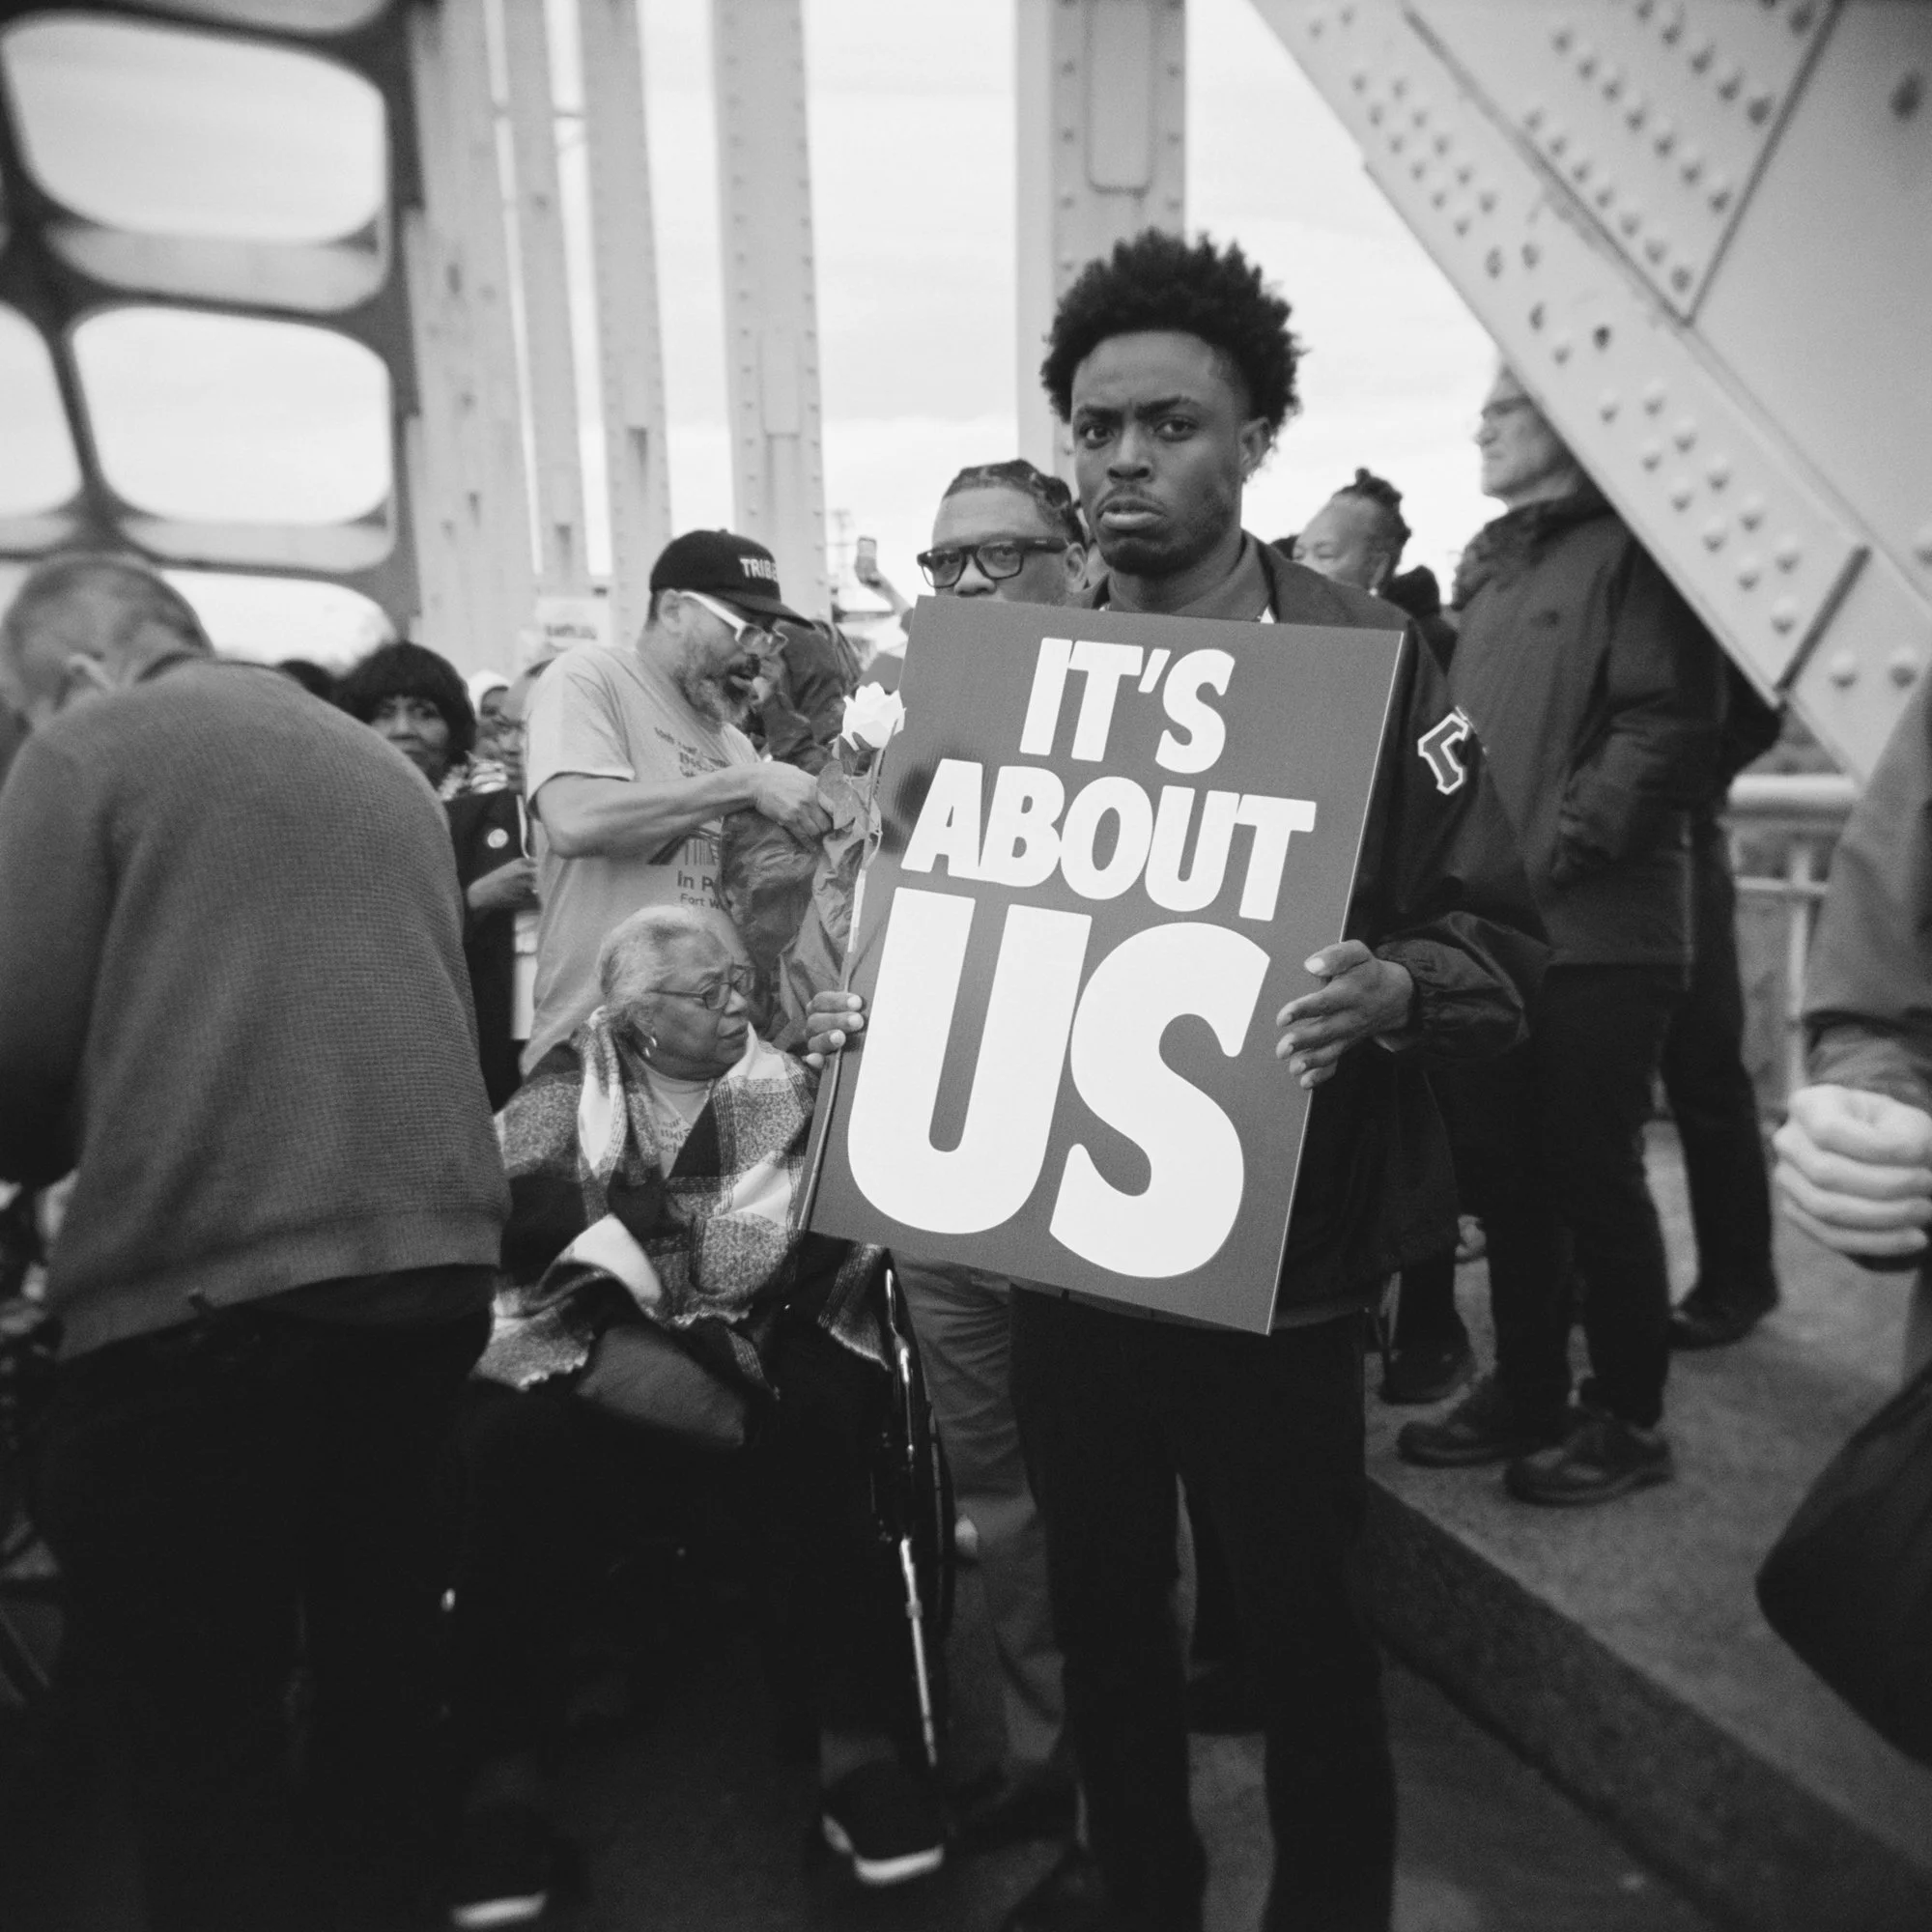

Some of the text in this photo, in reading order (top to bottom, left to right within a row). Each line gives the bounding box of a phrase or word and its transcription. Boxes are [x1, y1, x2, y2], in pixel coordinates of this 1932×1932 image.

[1019, 638, 1236, 774] IT'S
[677, 869, 695, 890] In
[680, 893, 705, 907] Fort
[900, 758, 1318, 922] ABOUT
[847, 887, 1271, 1278] US
